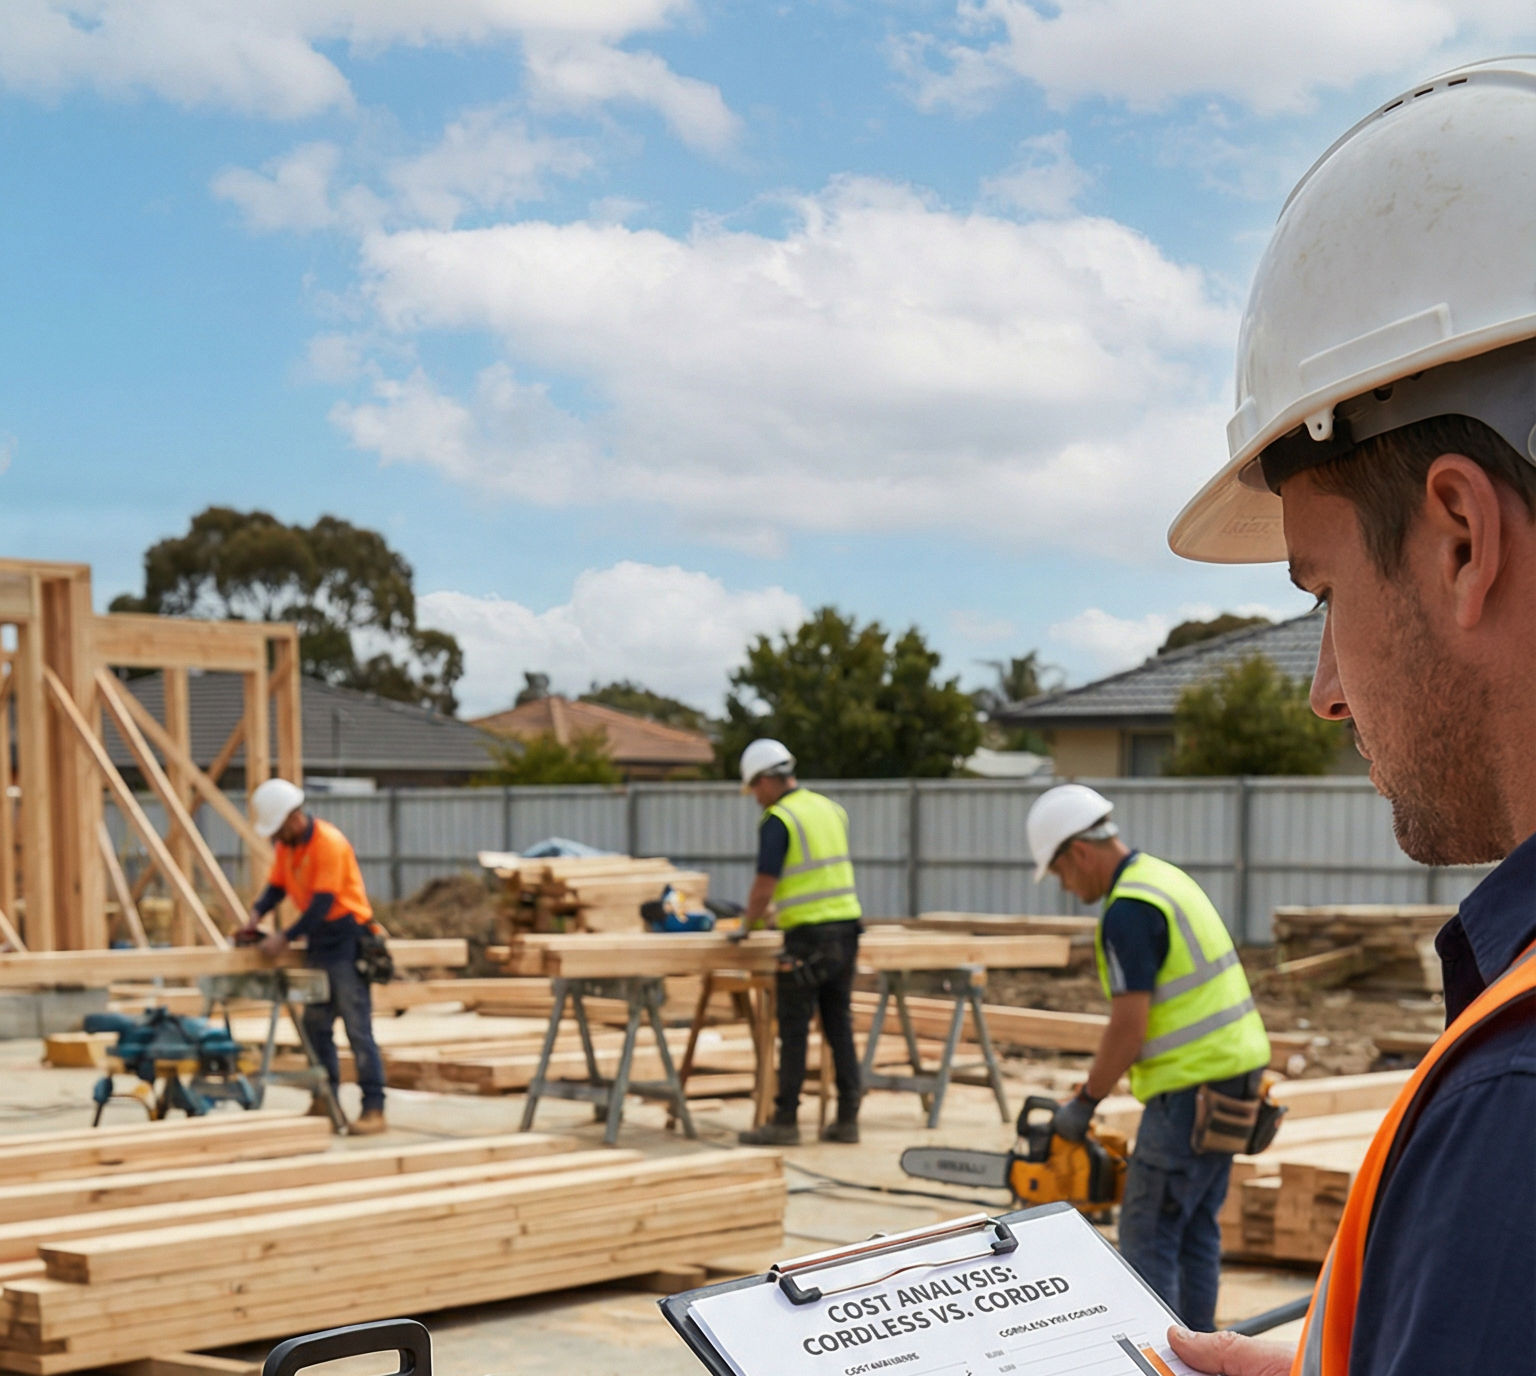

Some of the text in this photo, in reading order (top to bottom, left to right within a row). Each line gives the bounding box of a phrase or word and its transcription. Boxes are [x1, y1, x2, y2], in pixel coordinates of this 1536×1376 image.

[802, 1276, 1070, 1356] CORDLESS VS. CORDED
[828, 1265, 1018, 1323] COST ANALYSIS:
